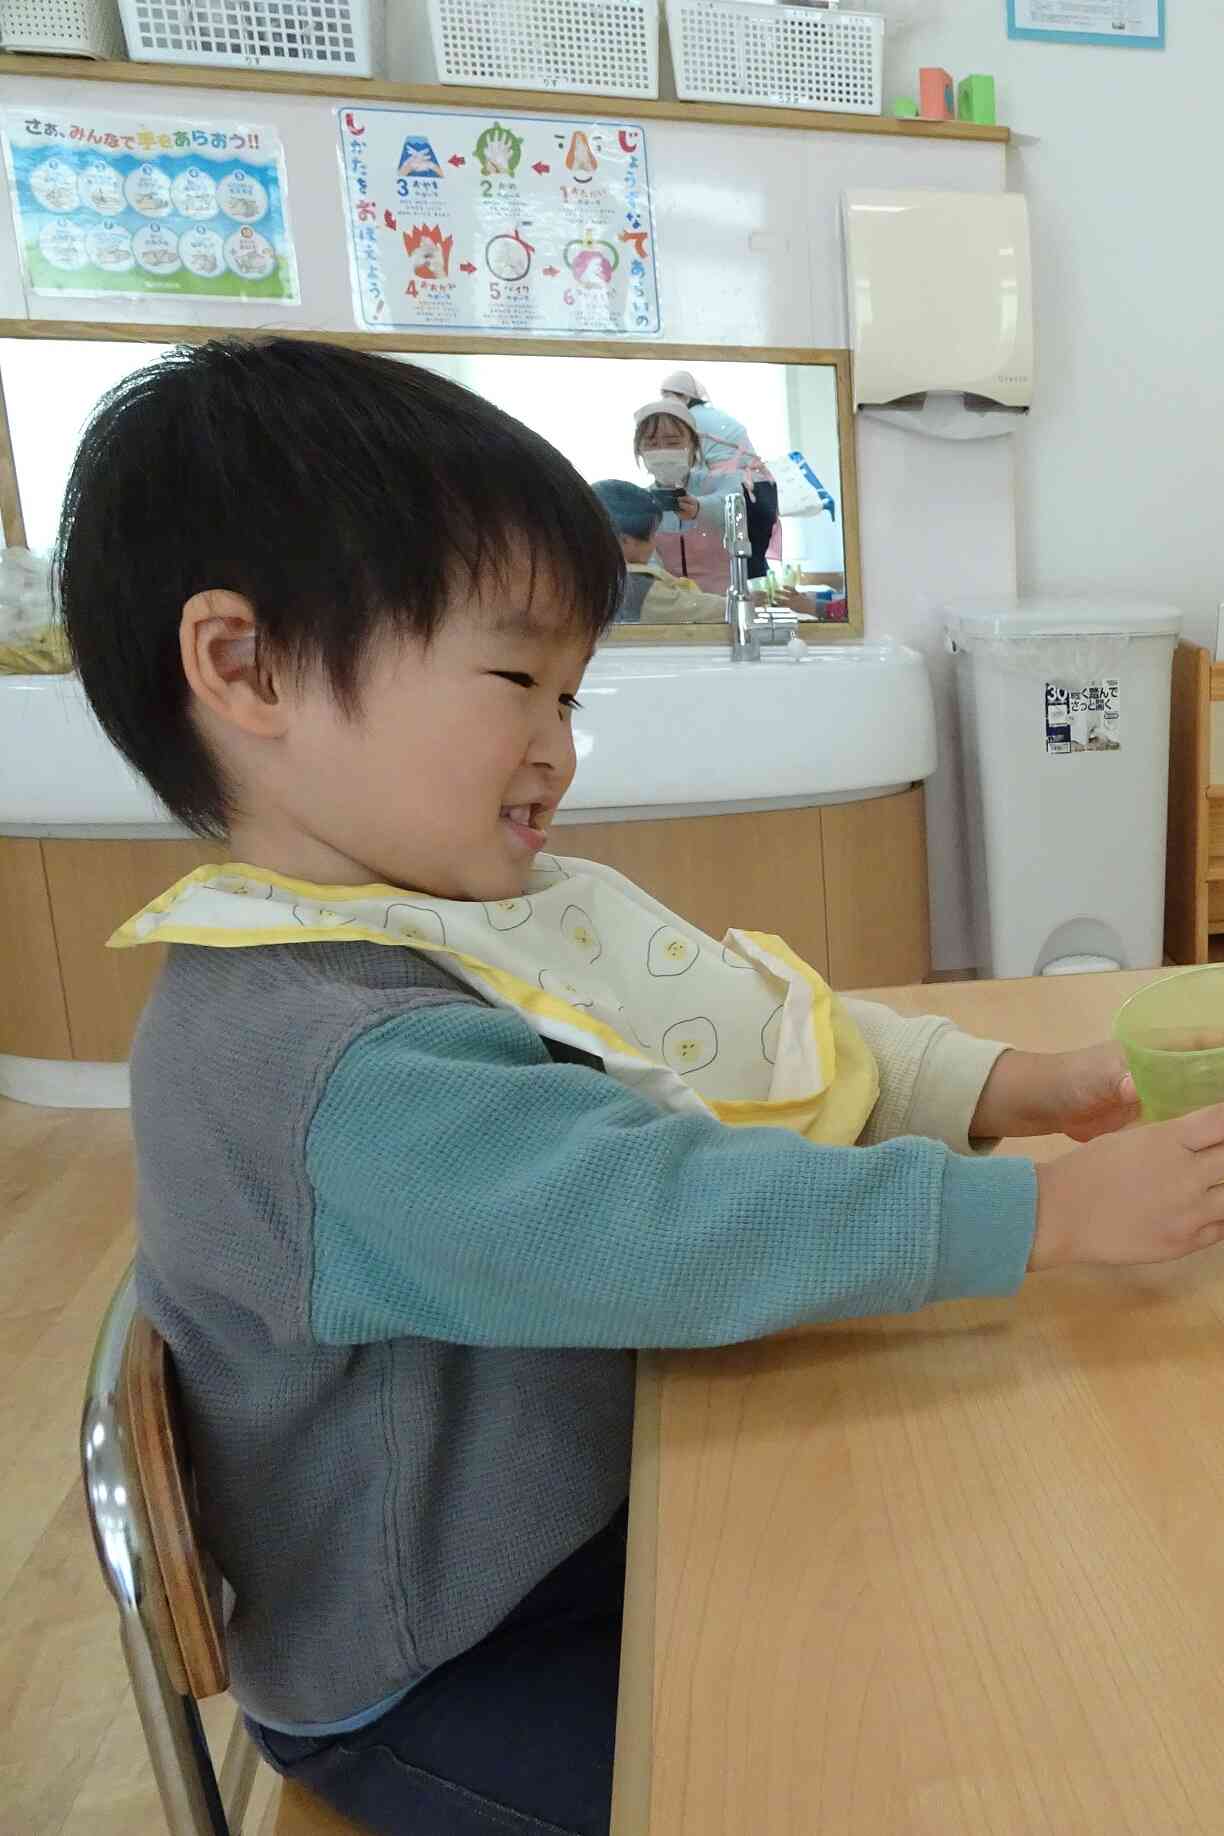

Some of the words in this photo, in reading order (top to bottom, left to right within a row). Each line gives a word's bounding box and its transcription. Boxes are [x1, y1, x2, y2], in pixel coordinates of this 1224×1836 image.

[396, 178, 409, 197] 3
[480, 179, 493, 198] 2
[405, 279, 418, 298] 4
[489, 282, 502, 300] 5
[563, 288, 575, 305] 6
